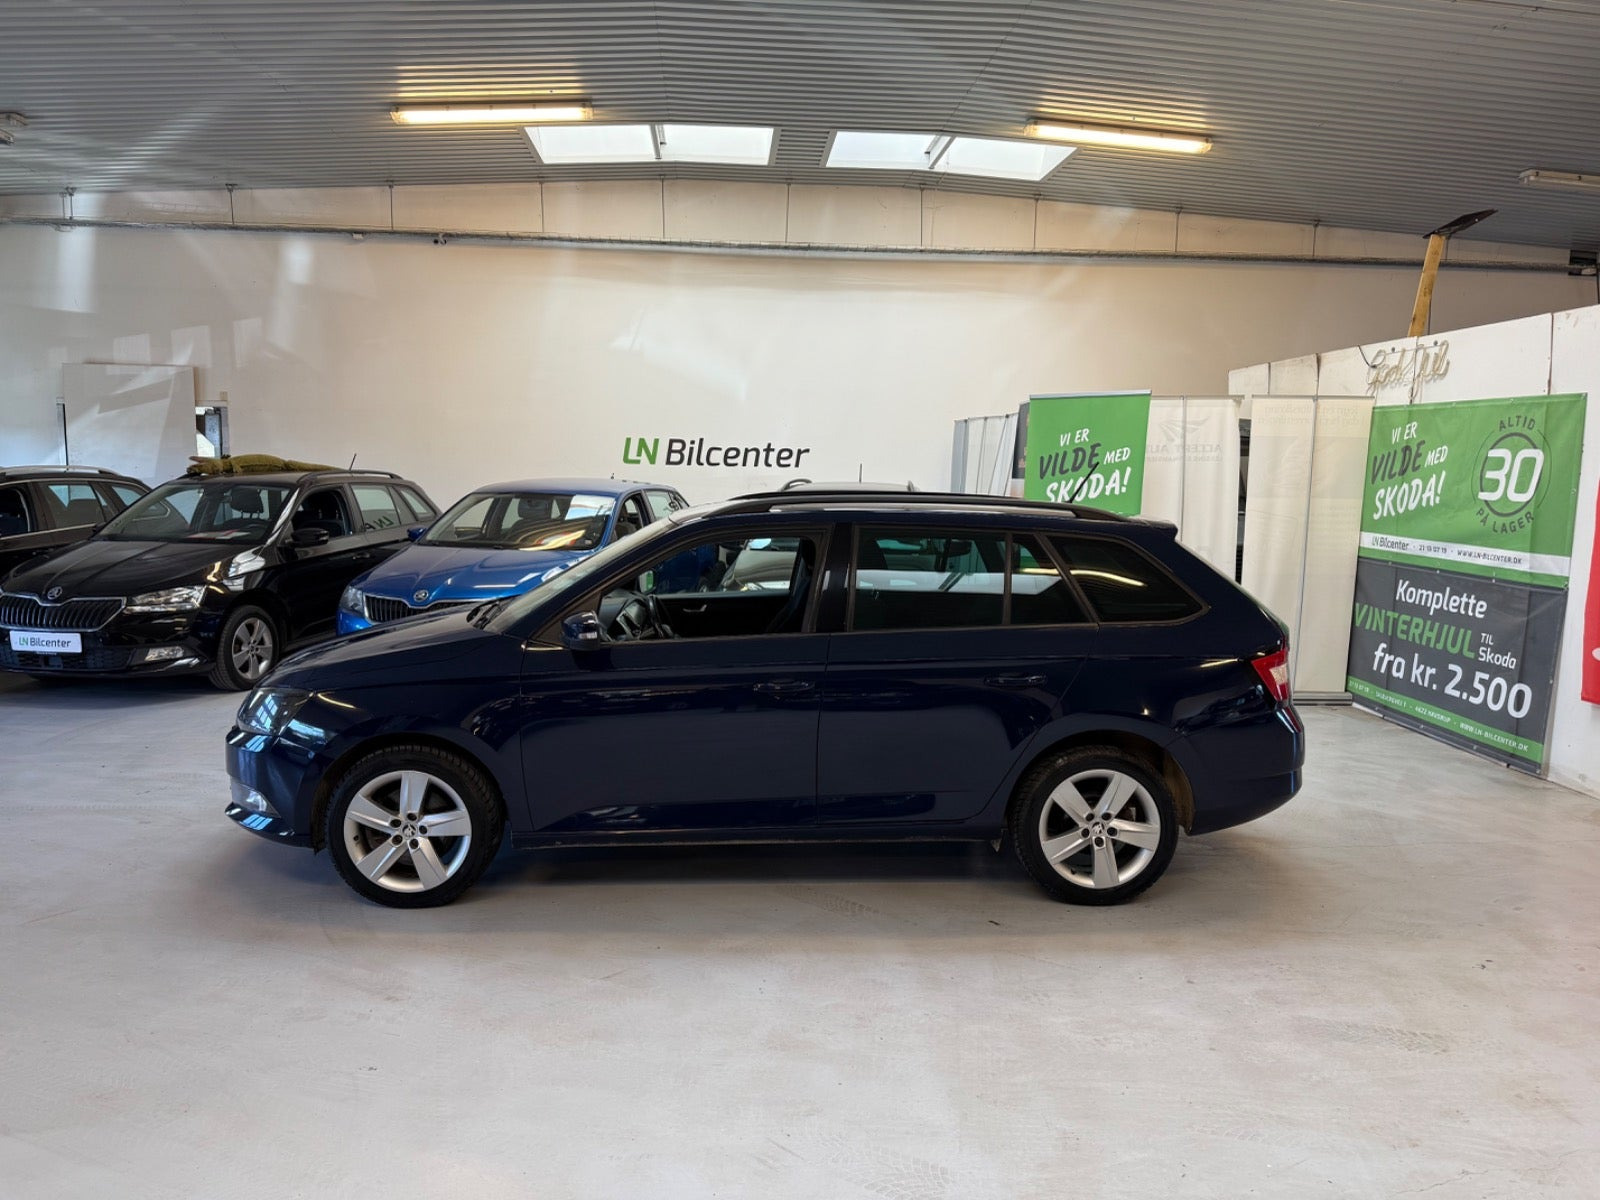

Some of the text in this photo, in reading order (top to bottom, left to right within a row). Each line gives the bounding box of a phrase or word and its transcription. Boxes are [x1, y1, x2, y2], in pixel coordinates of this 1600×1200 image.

[1060, 428, 1090, 447] VI ER
[1392, 421, 1418, 444] VI ER
[1499, 415, 1536, 431] ALTID
[622, 437, 810, 468] LN Bilcenter
[1040, 442, 1131, 480] VILDE MED
[1371, 440, 1448, 484] VILDE MED
[1046, 466, 1131, 503] SKODA!
[1477, 448, 1544, 502] 30
[1373, 470, 1446, 520] SKODA!
[1492, 511, 1535, 534] LAGER
[1380, 537, 1409, 550] Bilcenter
[1396, 579, 1488, 618] Komplette
[30, 637, 72, 648] Bilcenter
[1355, 602, 1475, 658] VINTERHJUL
[1480, 632, 1494, 645] TIL
[1478, 646, 1517, 670] Skoda
[1372, 643, 1406, 679] fra
[1410, 653, 1438, 690] kr.
[1444, 663, 1533, 719] 2.500
